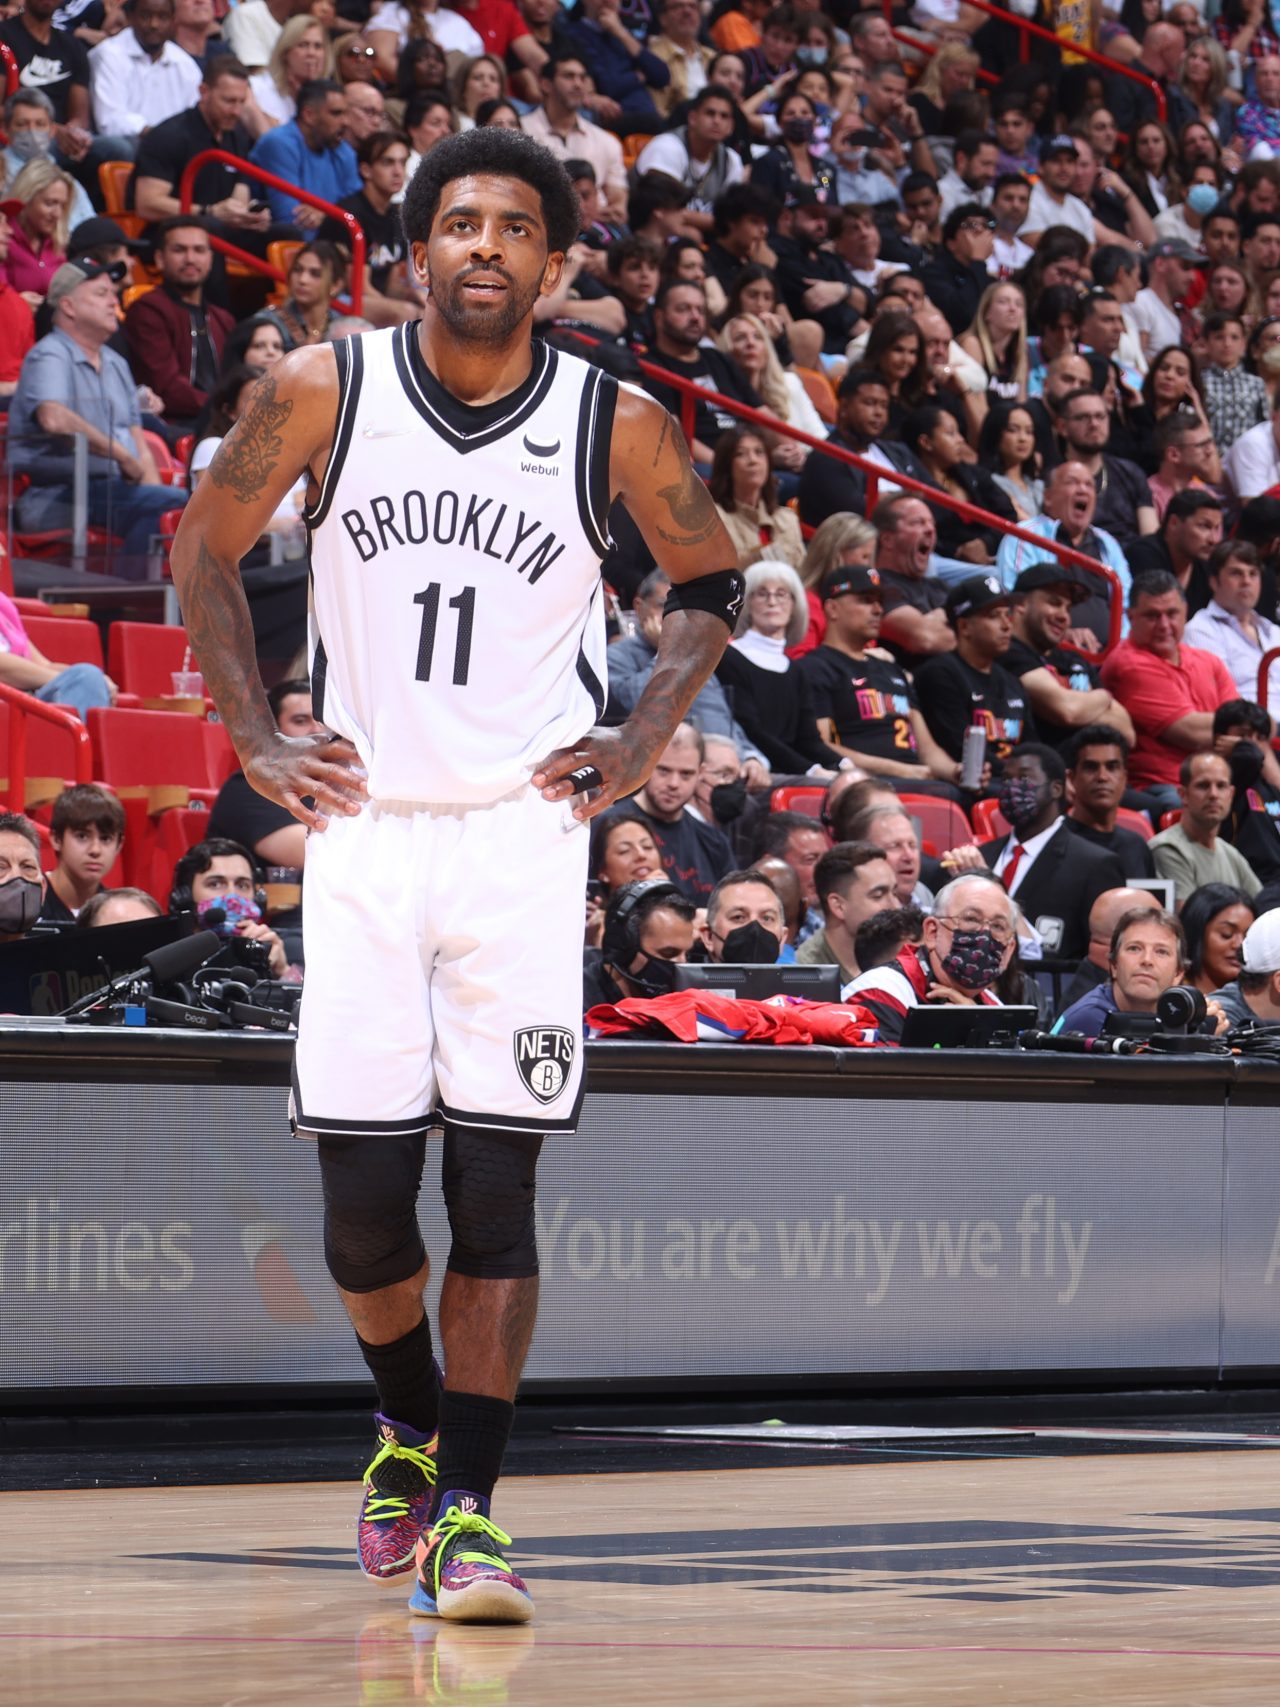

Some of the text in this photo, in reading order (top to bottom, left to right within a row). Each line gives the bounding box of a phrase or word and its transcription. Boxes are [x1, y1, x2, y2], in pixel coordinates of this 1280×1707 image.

[520, 461, 559, 477] Webull
[341, 489, 566, 586] BROOKLYN
[413, 582, 476, 687] 11
[519, 1030, 573, 1063] NETS
[542, 1064, 554, 1092] B
[534, 1193, 1094, 1306] You are why we fly
